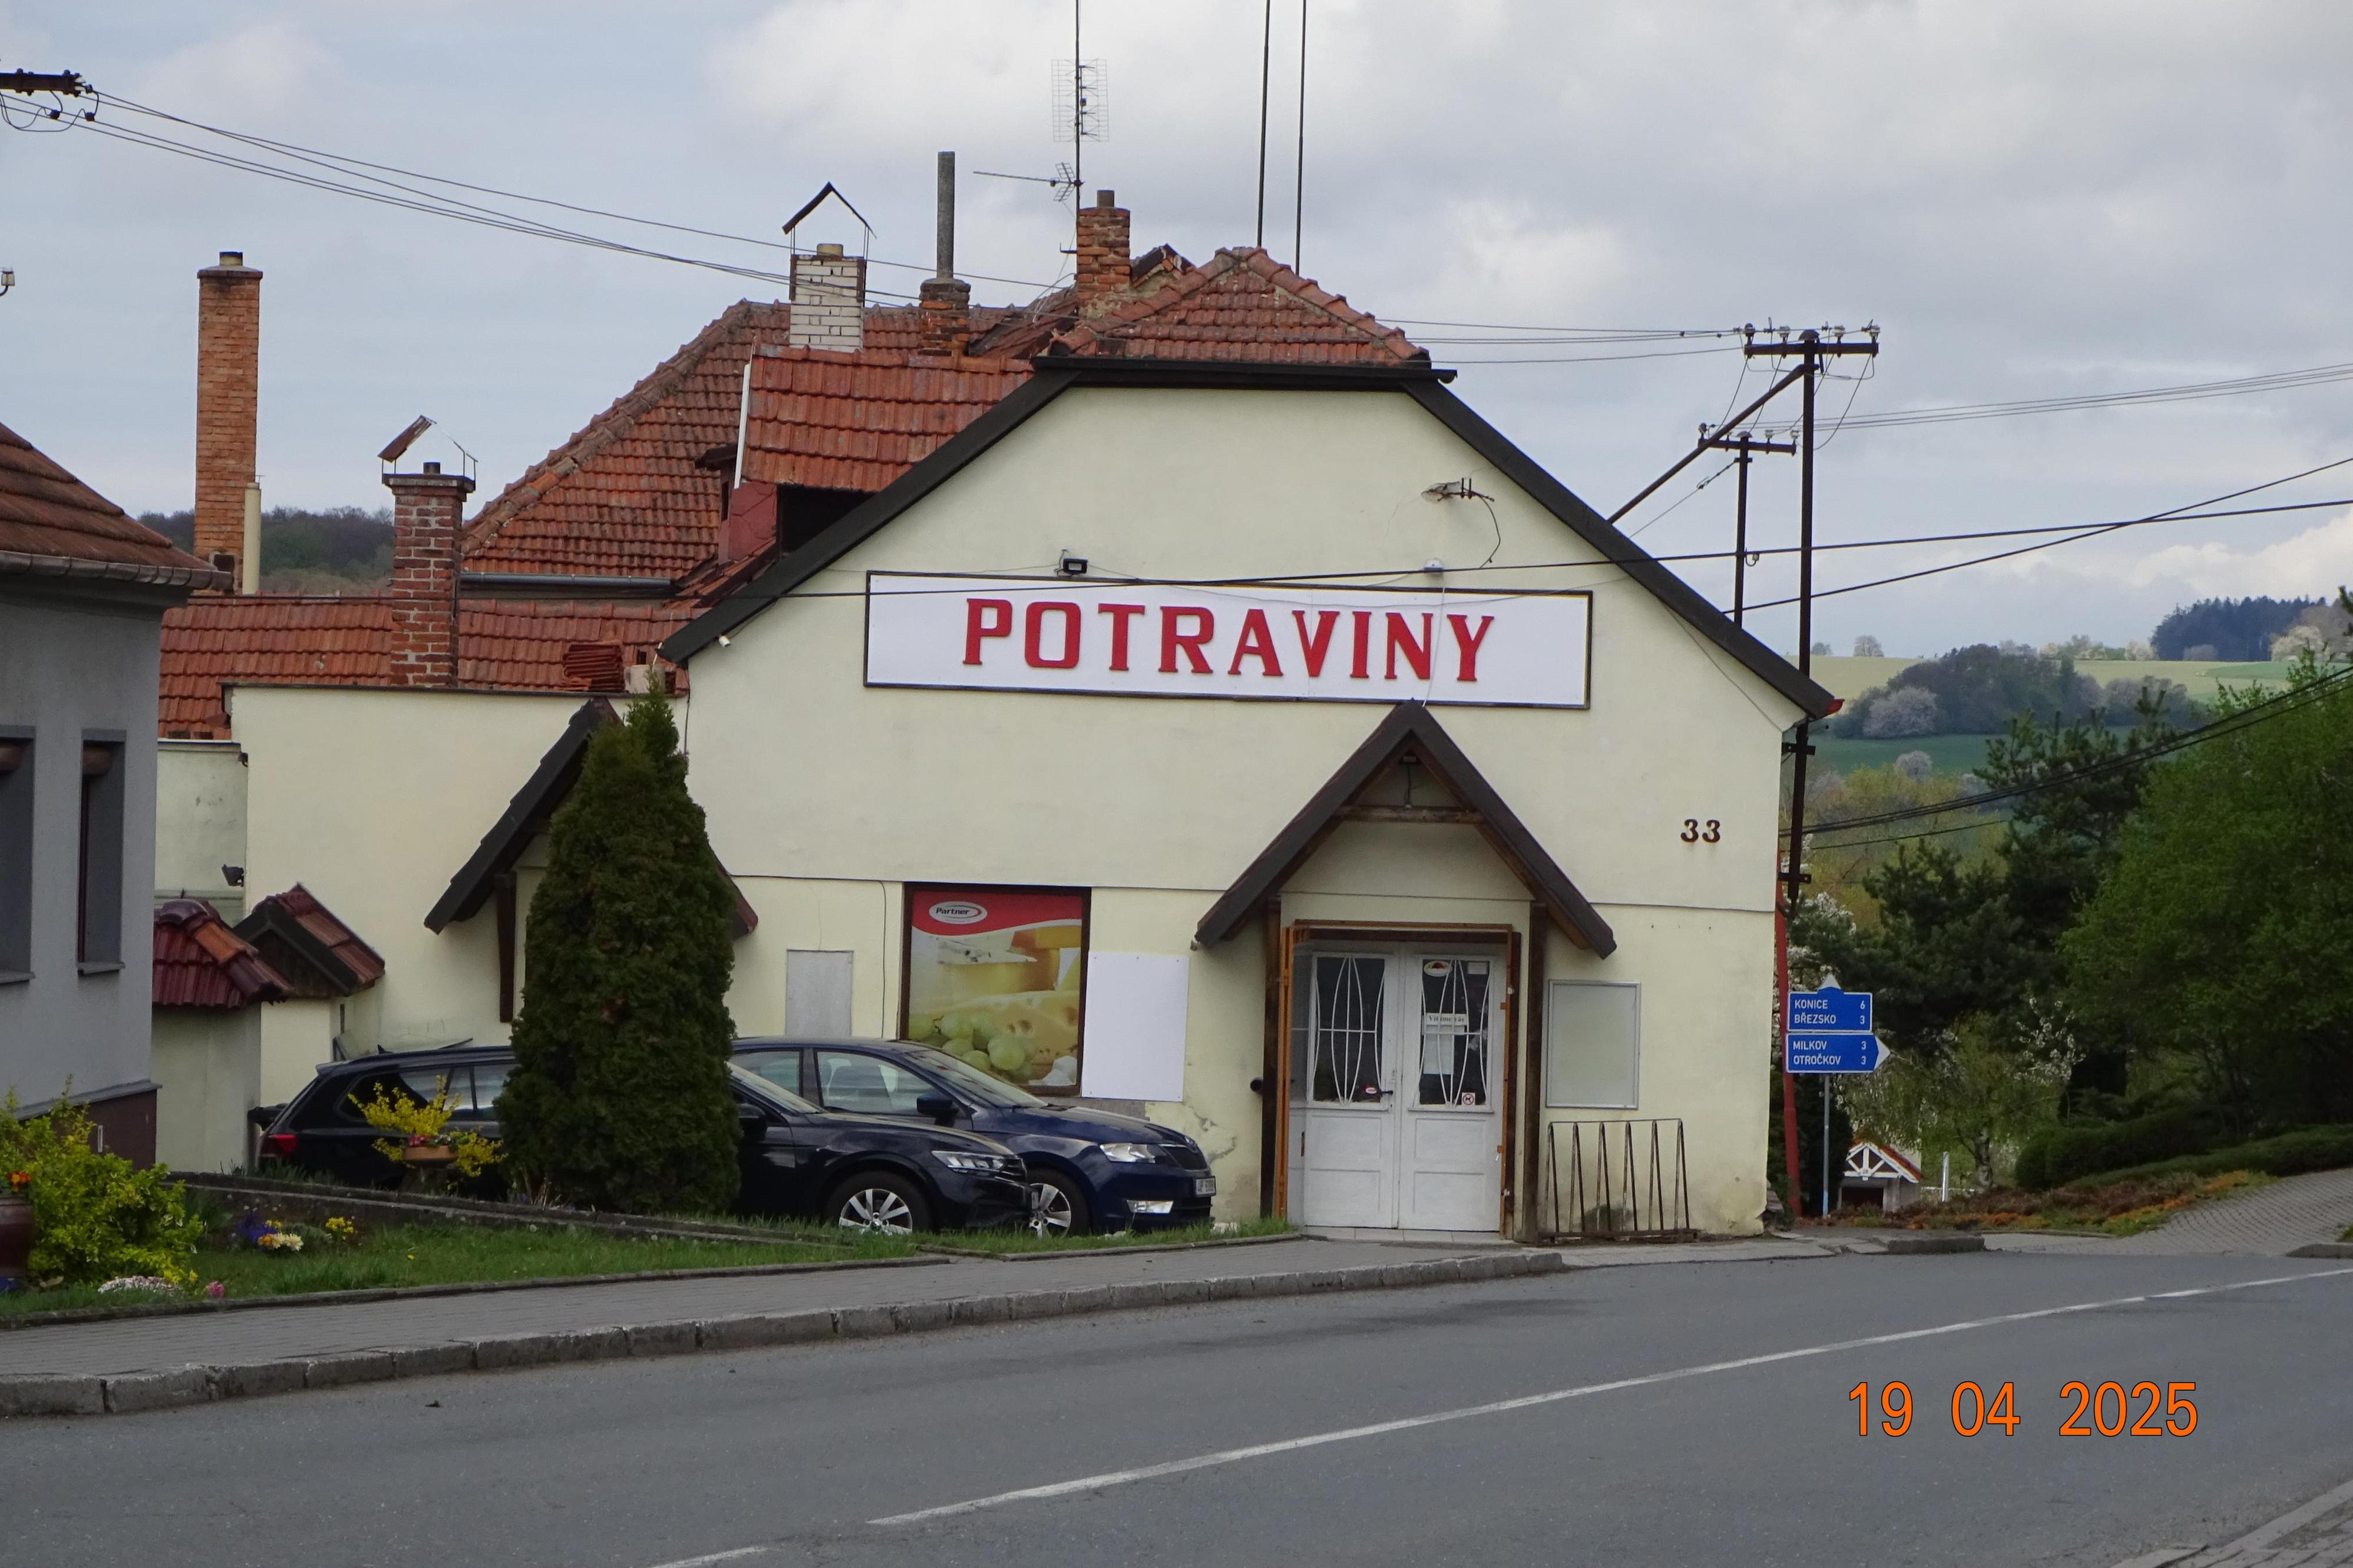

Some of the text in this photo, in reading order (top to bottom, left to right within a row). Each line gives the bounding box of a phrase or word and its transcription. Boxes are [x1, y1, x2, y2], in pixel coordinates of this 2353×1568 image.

[962, 598, 1495, 682] POTRAVINY
[1680, 819, 1721, 843] 33
[1794, 999, 1865, 1009] KONICE 6
[1794, 1012, 1865, 1025] BŘEZSKO 3
[1793, 1040, 1867, 1050] MILKOV 3
[1793, 1053, 1866, 1065] OTROČKOV 3
